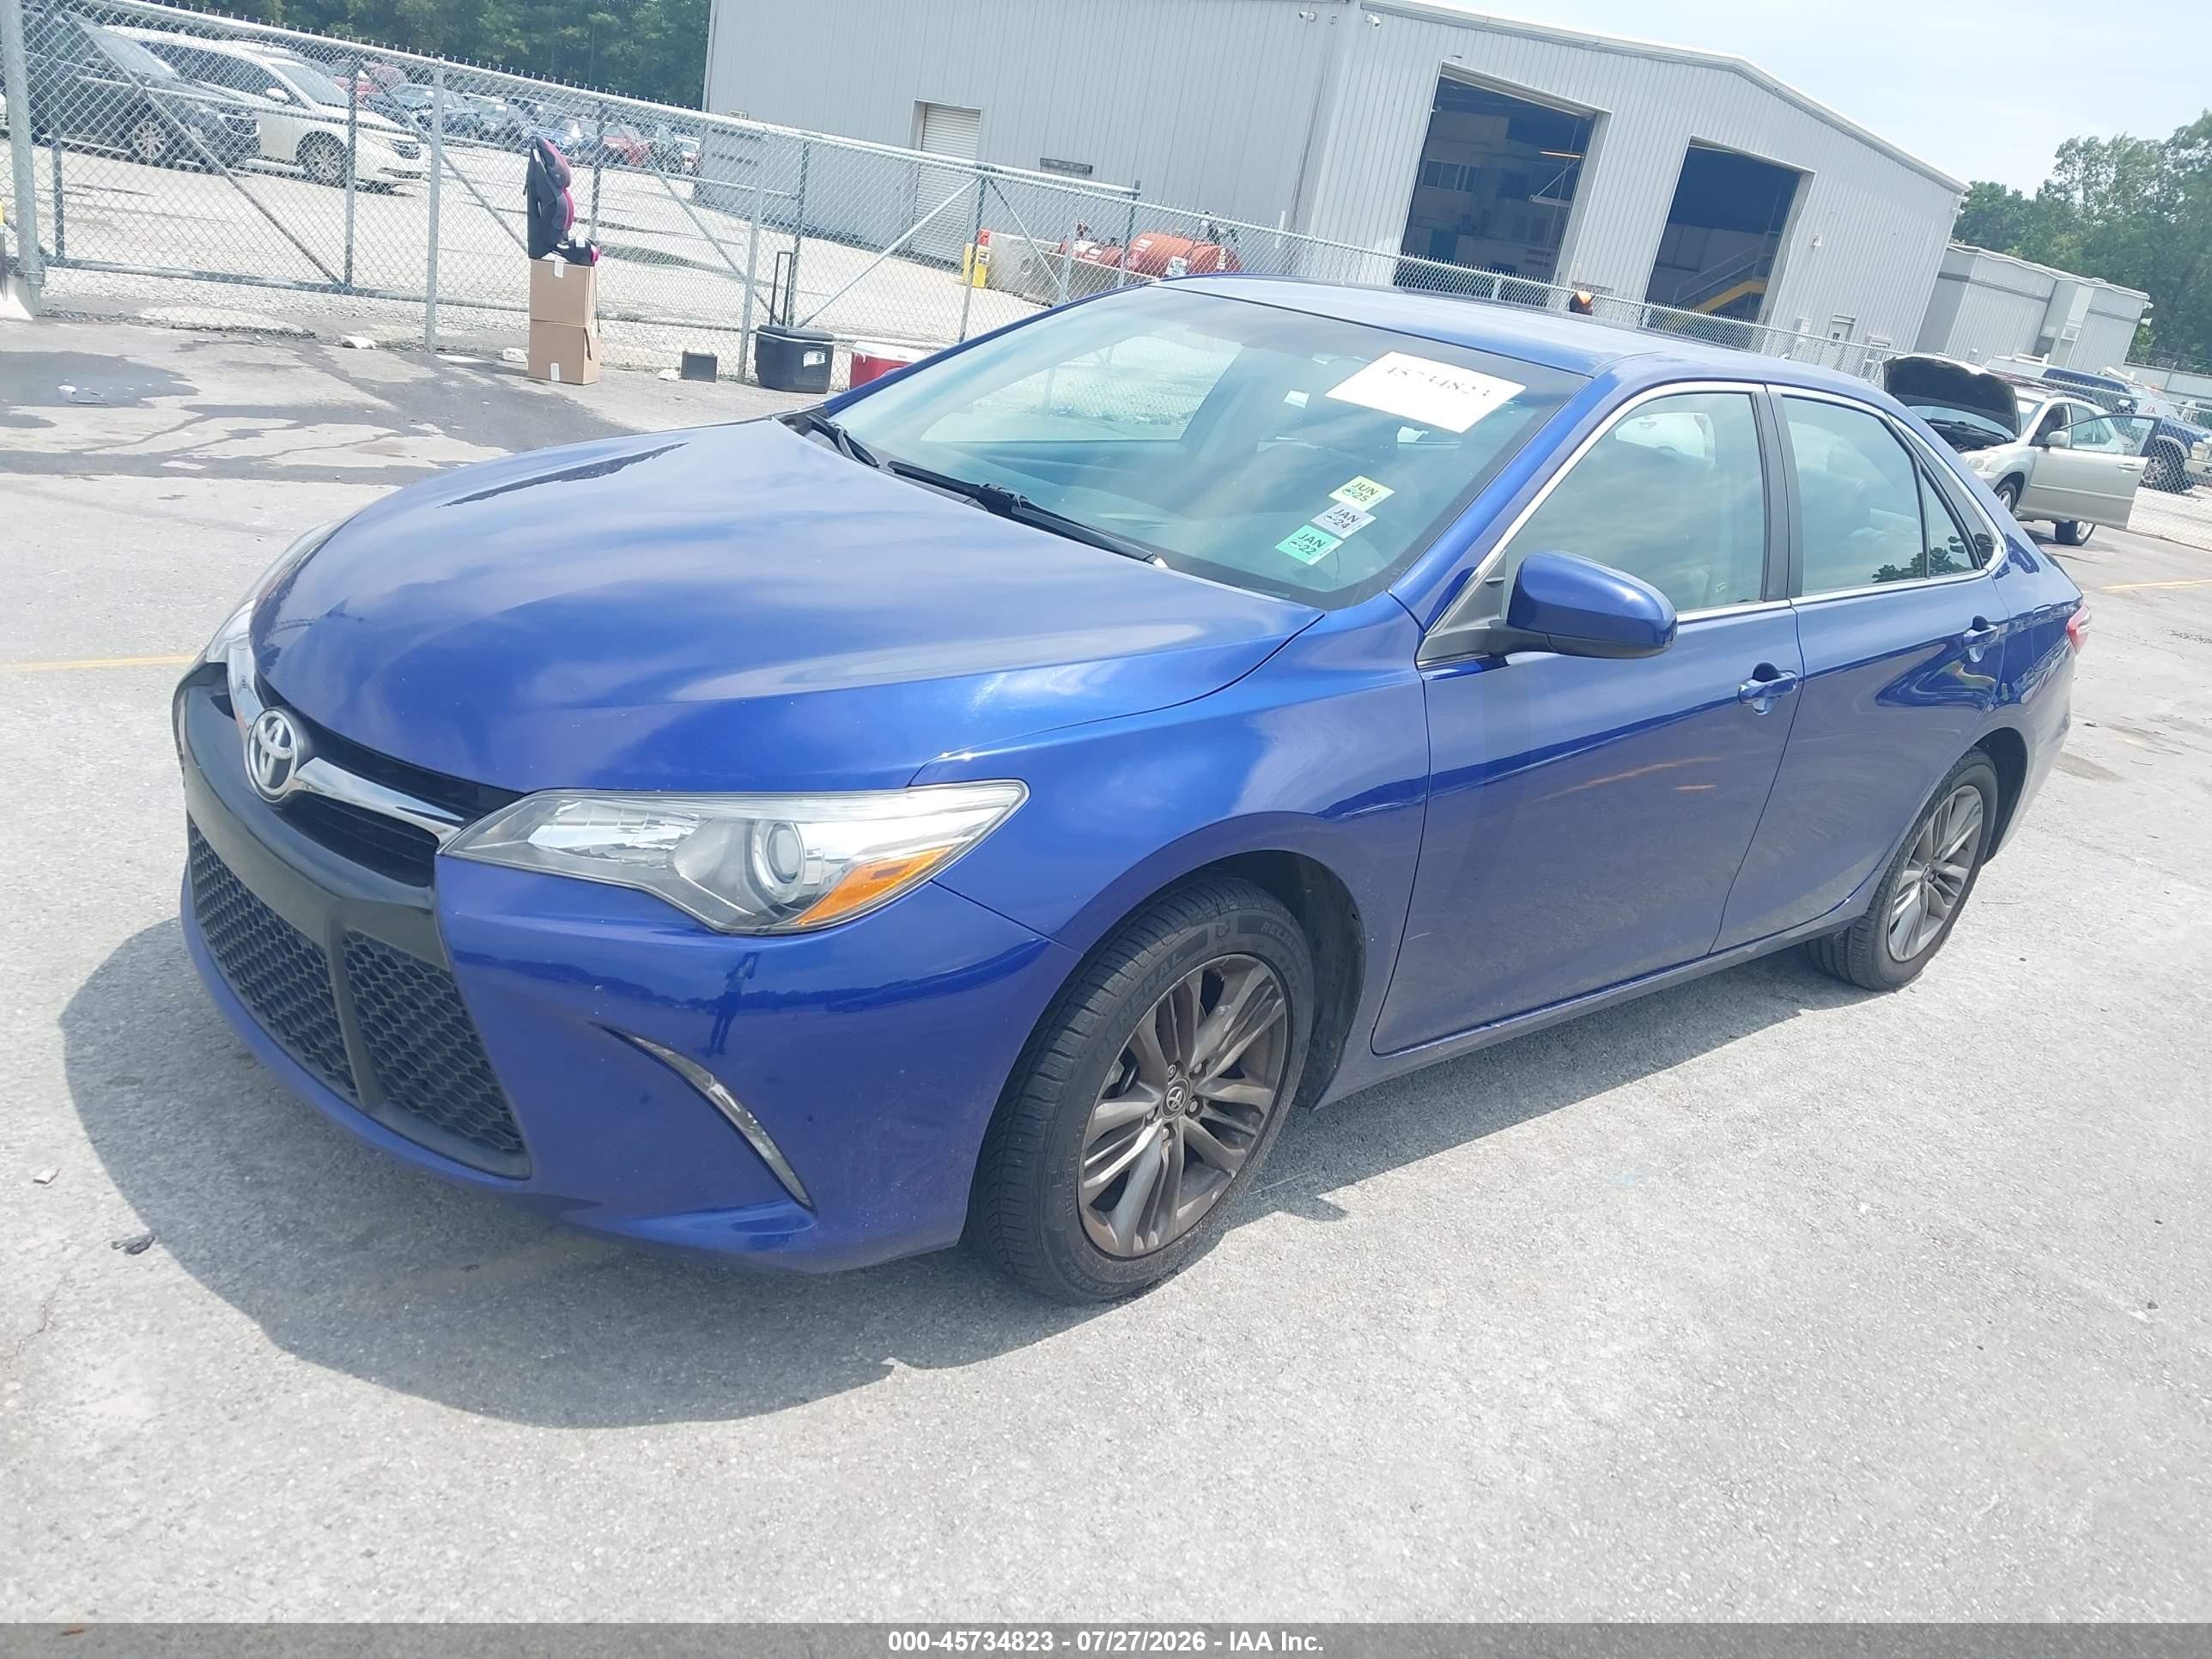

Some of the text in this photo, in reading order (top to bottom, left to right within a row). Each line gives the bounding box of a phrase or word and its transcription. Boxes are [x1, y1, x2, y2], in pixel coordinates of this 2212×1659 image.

[1352, 482, 1379, 496] JUN
[1352, 492, 1371, 502] 25
[1333, 508, 1361, 523] JAN
[1334, 519, 1352, 530] 24
[1297, 532, 1327, 548] JAN
[1298, 544, 1317, 556] 22
